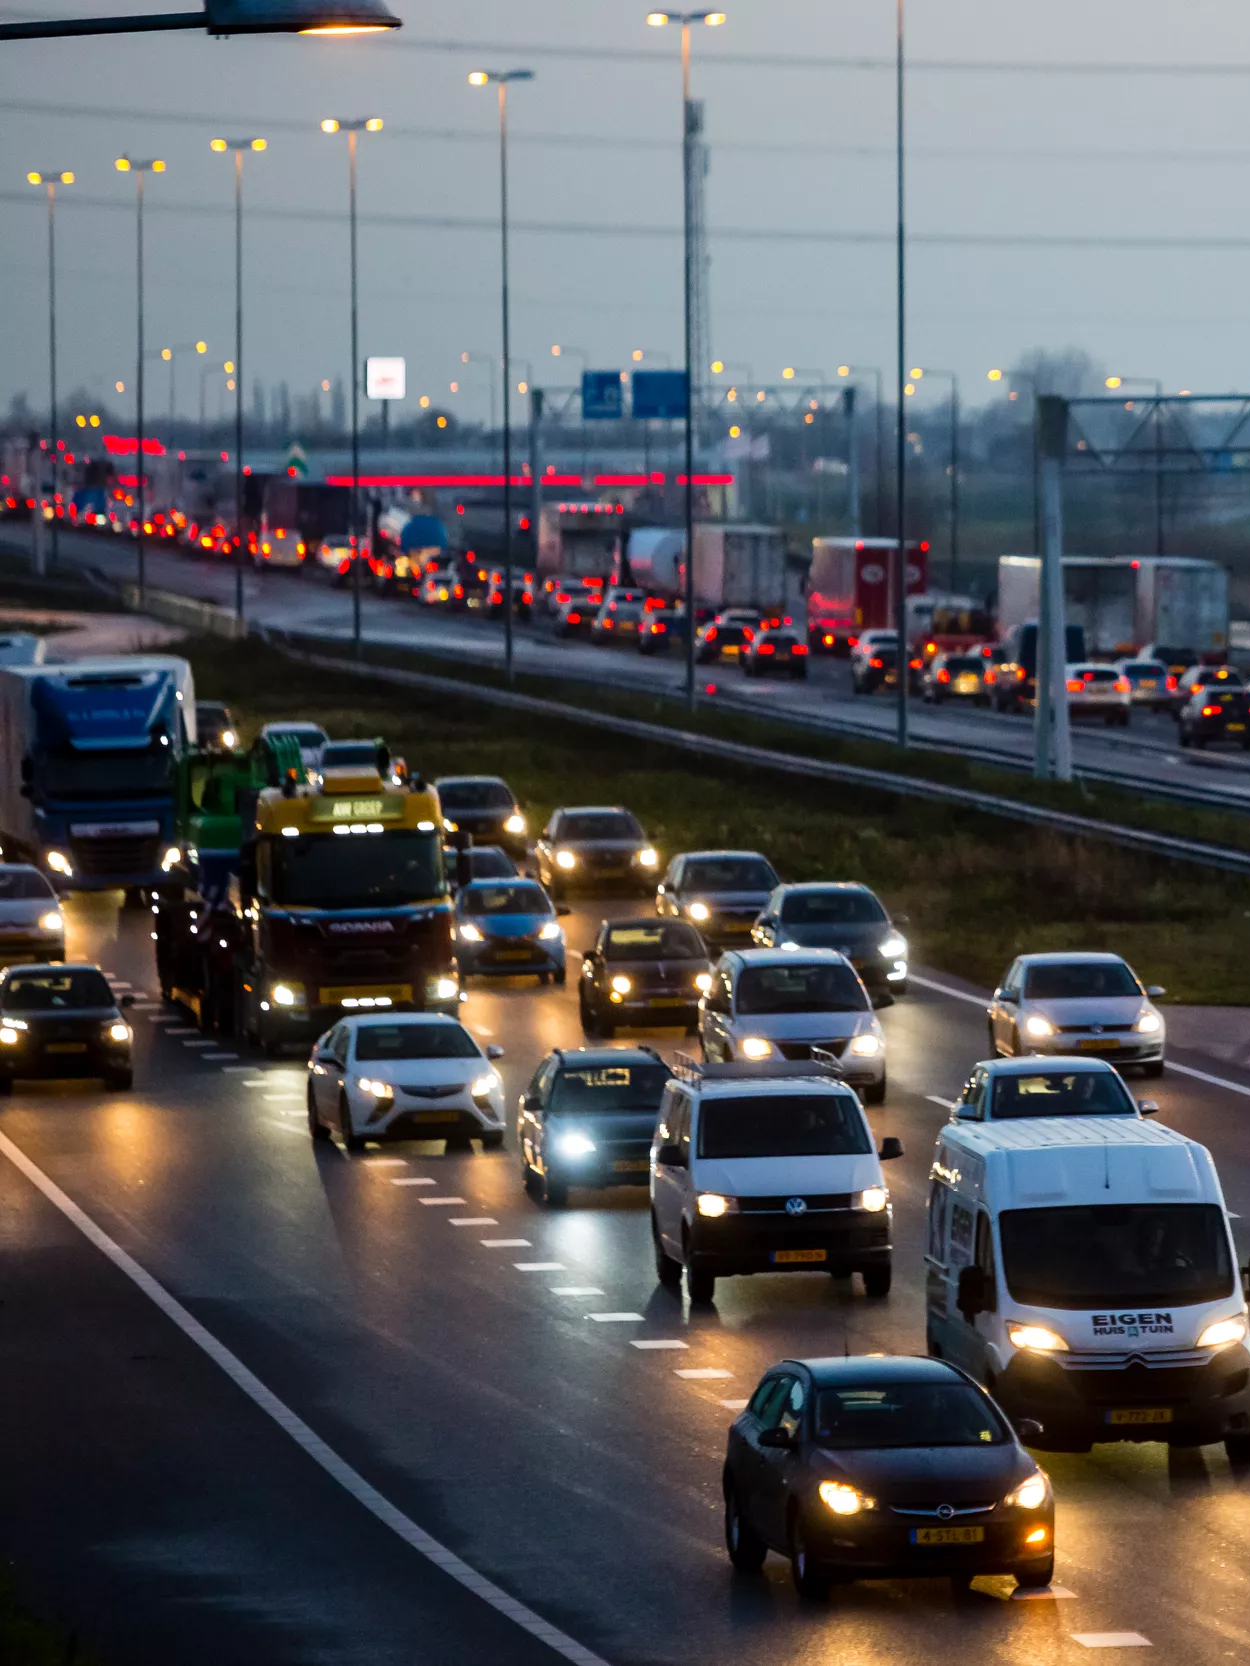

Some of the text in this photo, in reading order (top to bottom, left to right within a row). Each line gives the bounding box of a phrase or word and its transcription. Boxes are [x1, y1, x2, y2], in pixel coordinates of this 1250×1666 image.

[1092, 1312, 1173, 1327] EIGEN
[1093, 1324, 1174, 1336] HUIS TUIN
